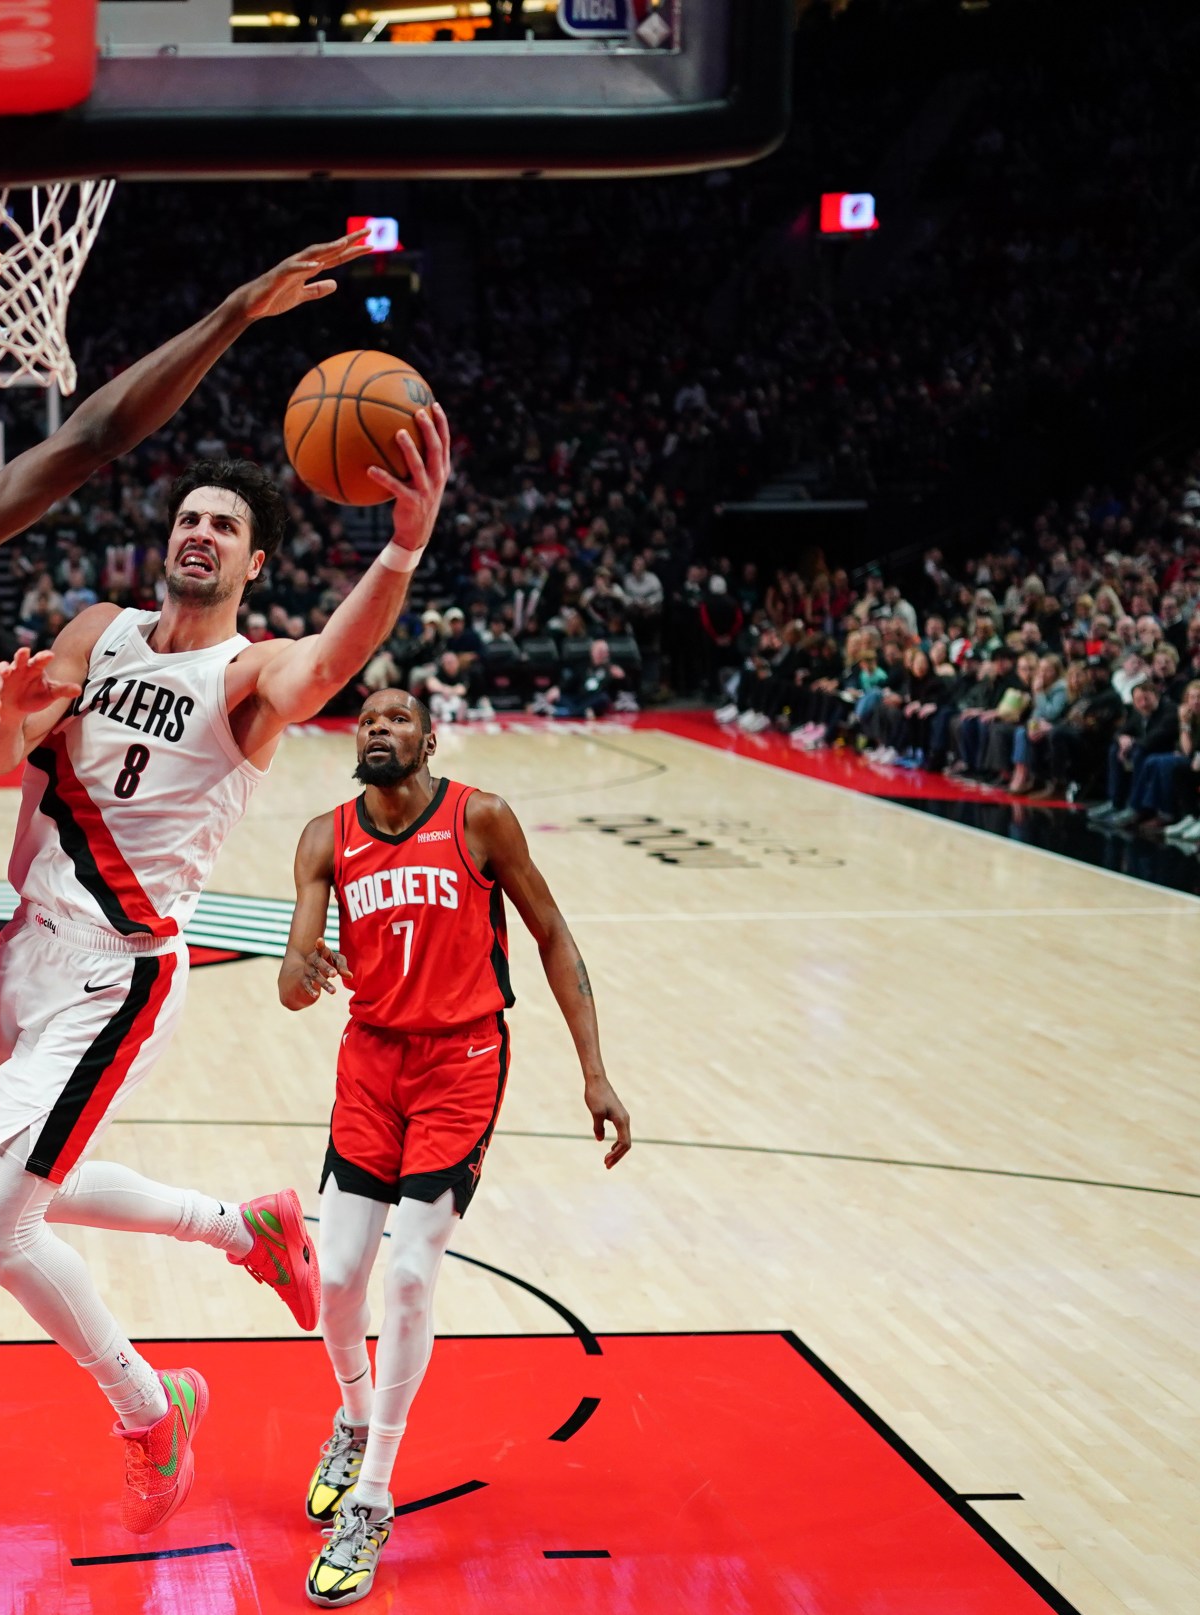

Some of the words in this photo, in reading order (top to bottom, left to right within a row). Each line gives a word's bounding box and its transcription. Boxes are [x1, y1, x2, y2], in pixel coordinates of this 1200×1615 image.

[65, 676, 195, 743] LAZERS
[114, 743, 150, 799] 8
[343, 865, 459, 923] ROCKETS
[391, 919, 414, 977] 7
